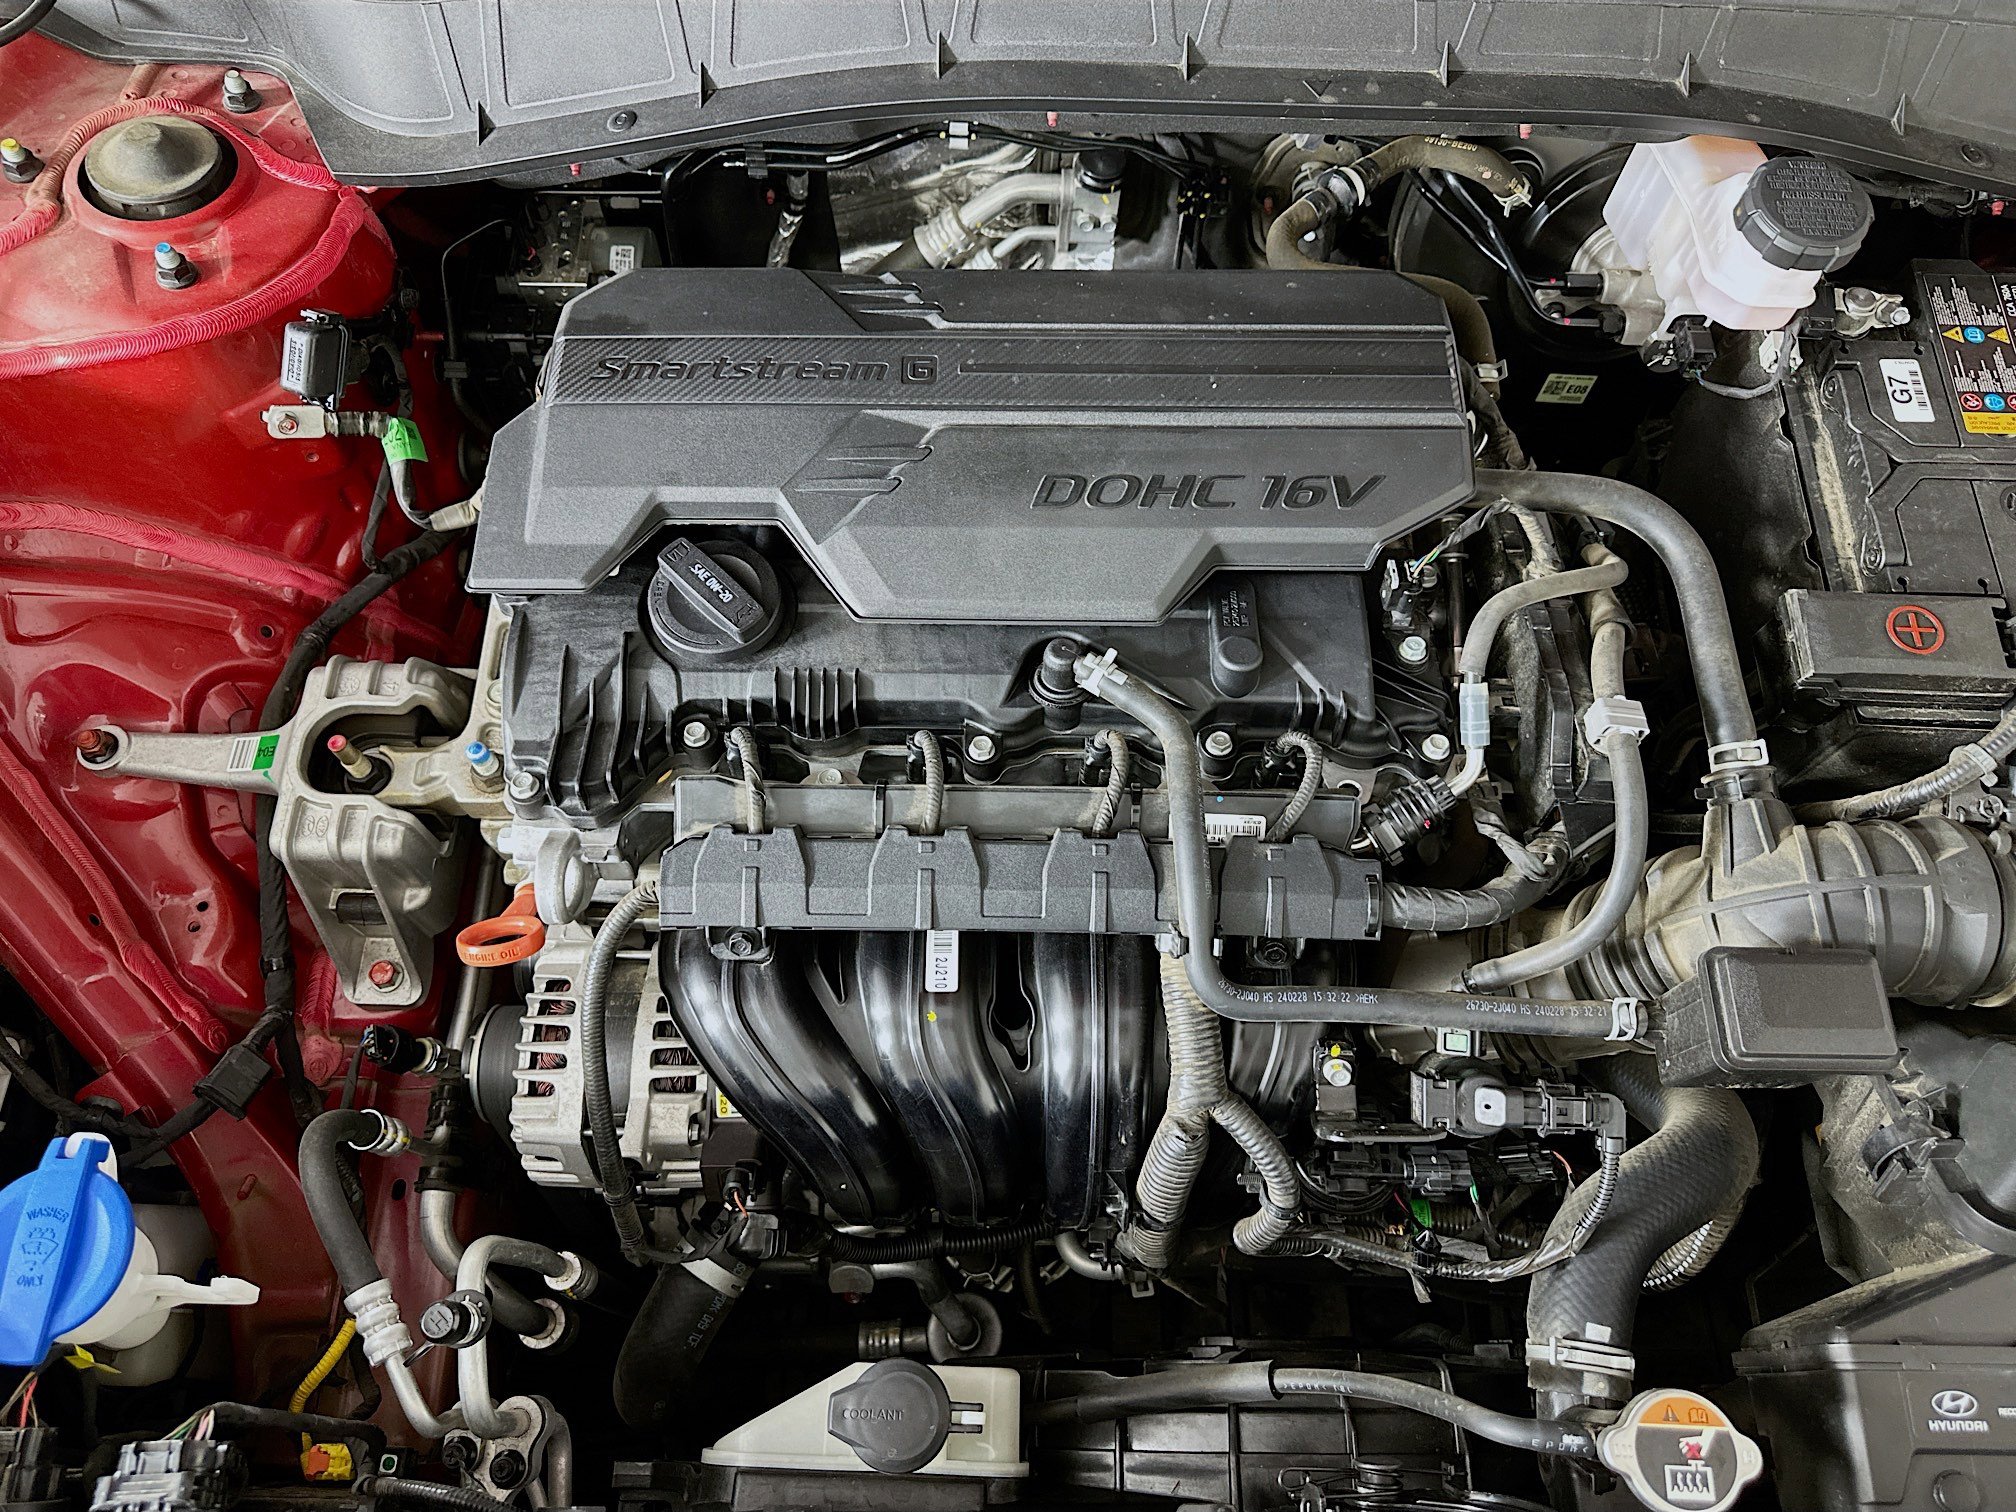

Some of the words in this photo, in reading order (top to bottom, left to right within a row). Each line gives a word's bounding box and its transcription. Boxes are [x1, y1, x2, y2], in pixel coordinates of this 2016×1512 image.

[591, 356, 890, 381] Smartstream
[904, 357, 936, 382] G
[1566, 385, 1588, 394] E08
[1887, 376, 1913, 404] G7
[1030, 474, 1246, 510] DOHC
[1260, 474, 1387, 510] 16V
[688, 562, 711, 582] SAE
[705, 577, 734, 603] 0W-20
[464, 952, 497, 961] ENGINE
[500, 947, 520, 959] OIL
[934, 957, 948, 989] 2J210
[1218, 979, 1259, 1002] 26730-2J040
[1264, 993, 1274, 1002] HS
[1278, 992, 1308, 1002] 240228
[1313, 991, 1350, 1002] 15:32:22
[1466, 1000, 1517, 1014] 26730-2J040
[1520, 1005, 1531, 1015] HS
[1535, 1005, 1564, 1016] 240228
[1570, 1006, 1607, 1017] 15:32:21
[26, 1206, 70, 1223] WASHER
[16, 1274, 44, 1287] ONLY
[842, 1408, 904, 1421] COOLANT
[1928, 1420, 1989, 1432] HYUNDAI
